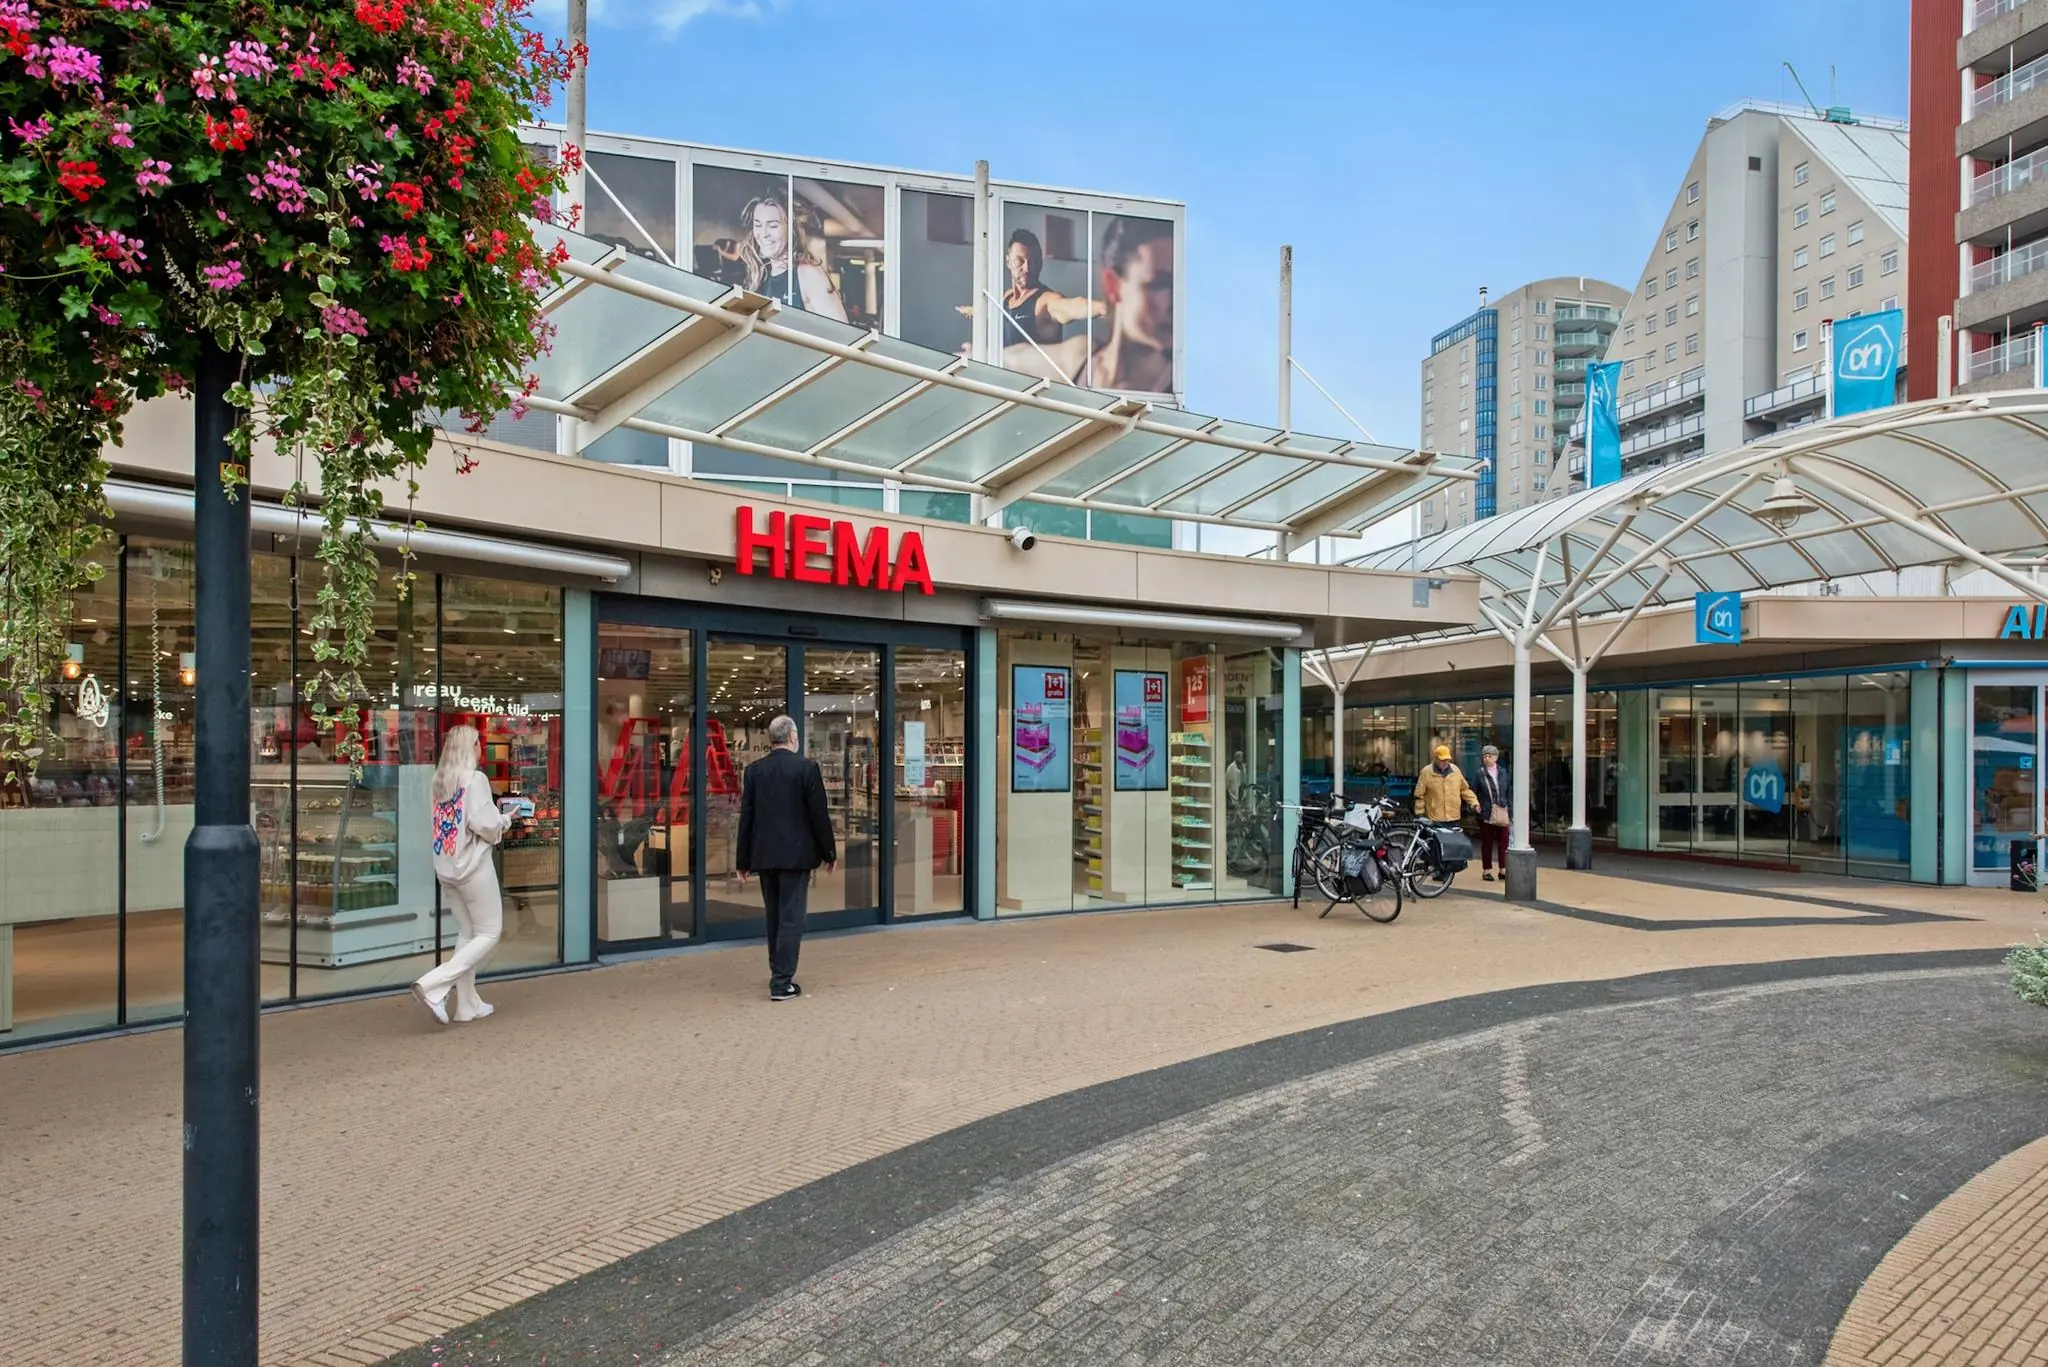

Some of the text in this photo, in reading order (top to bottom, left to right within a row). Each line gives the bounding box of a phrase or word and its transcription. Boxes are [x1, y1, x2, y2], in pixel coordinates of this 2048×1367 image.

[736, 505, 936, 596] HEMA
[453, 694, 496, 708] feest
[507, 702, 529, 716] tijd
